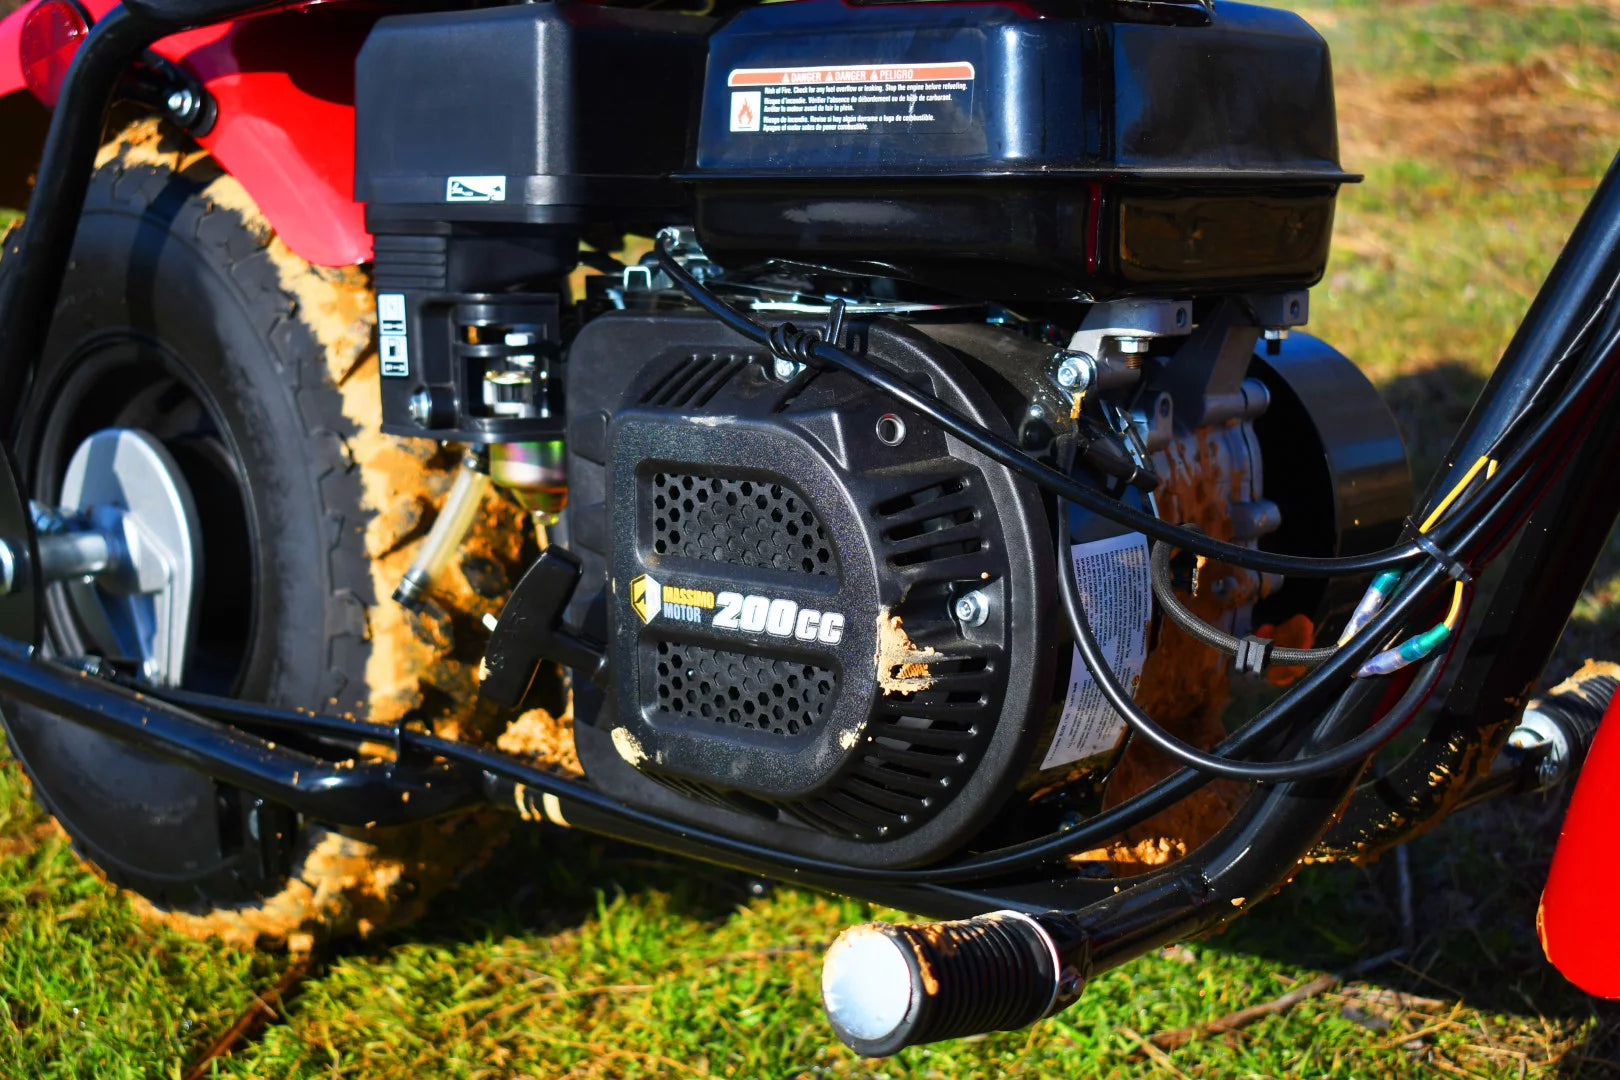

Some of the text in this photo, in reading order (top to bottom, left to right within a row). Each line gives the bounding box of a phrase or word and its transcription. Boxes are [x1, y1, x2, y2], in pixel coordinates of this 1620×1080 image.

[791, 70, 913, 83] DANGER DANGER PELIGRO
[836, 84, 857, 93] overflow
[885, 84, 897, 92] Stop
[907, 84, 924, 92] engine
[663, 585, 714, 609] MASSIMO
[664, 603, 701, 623] MOTOR
